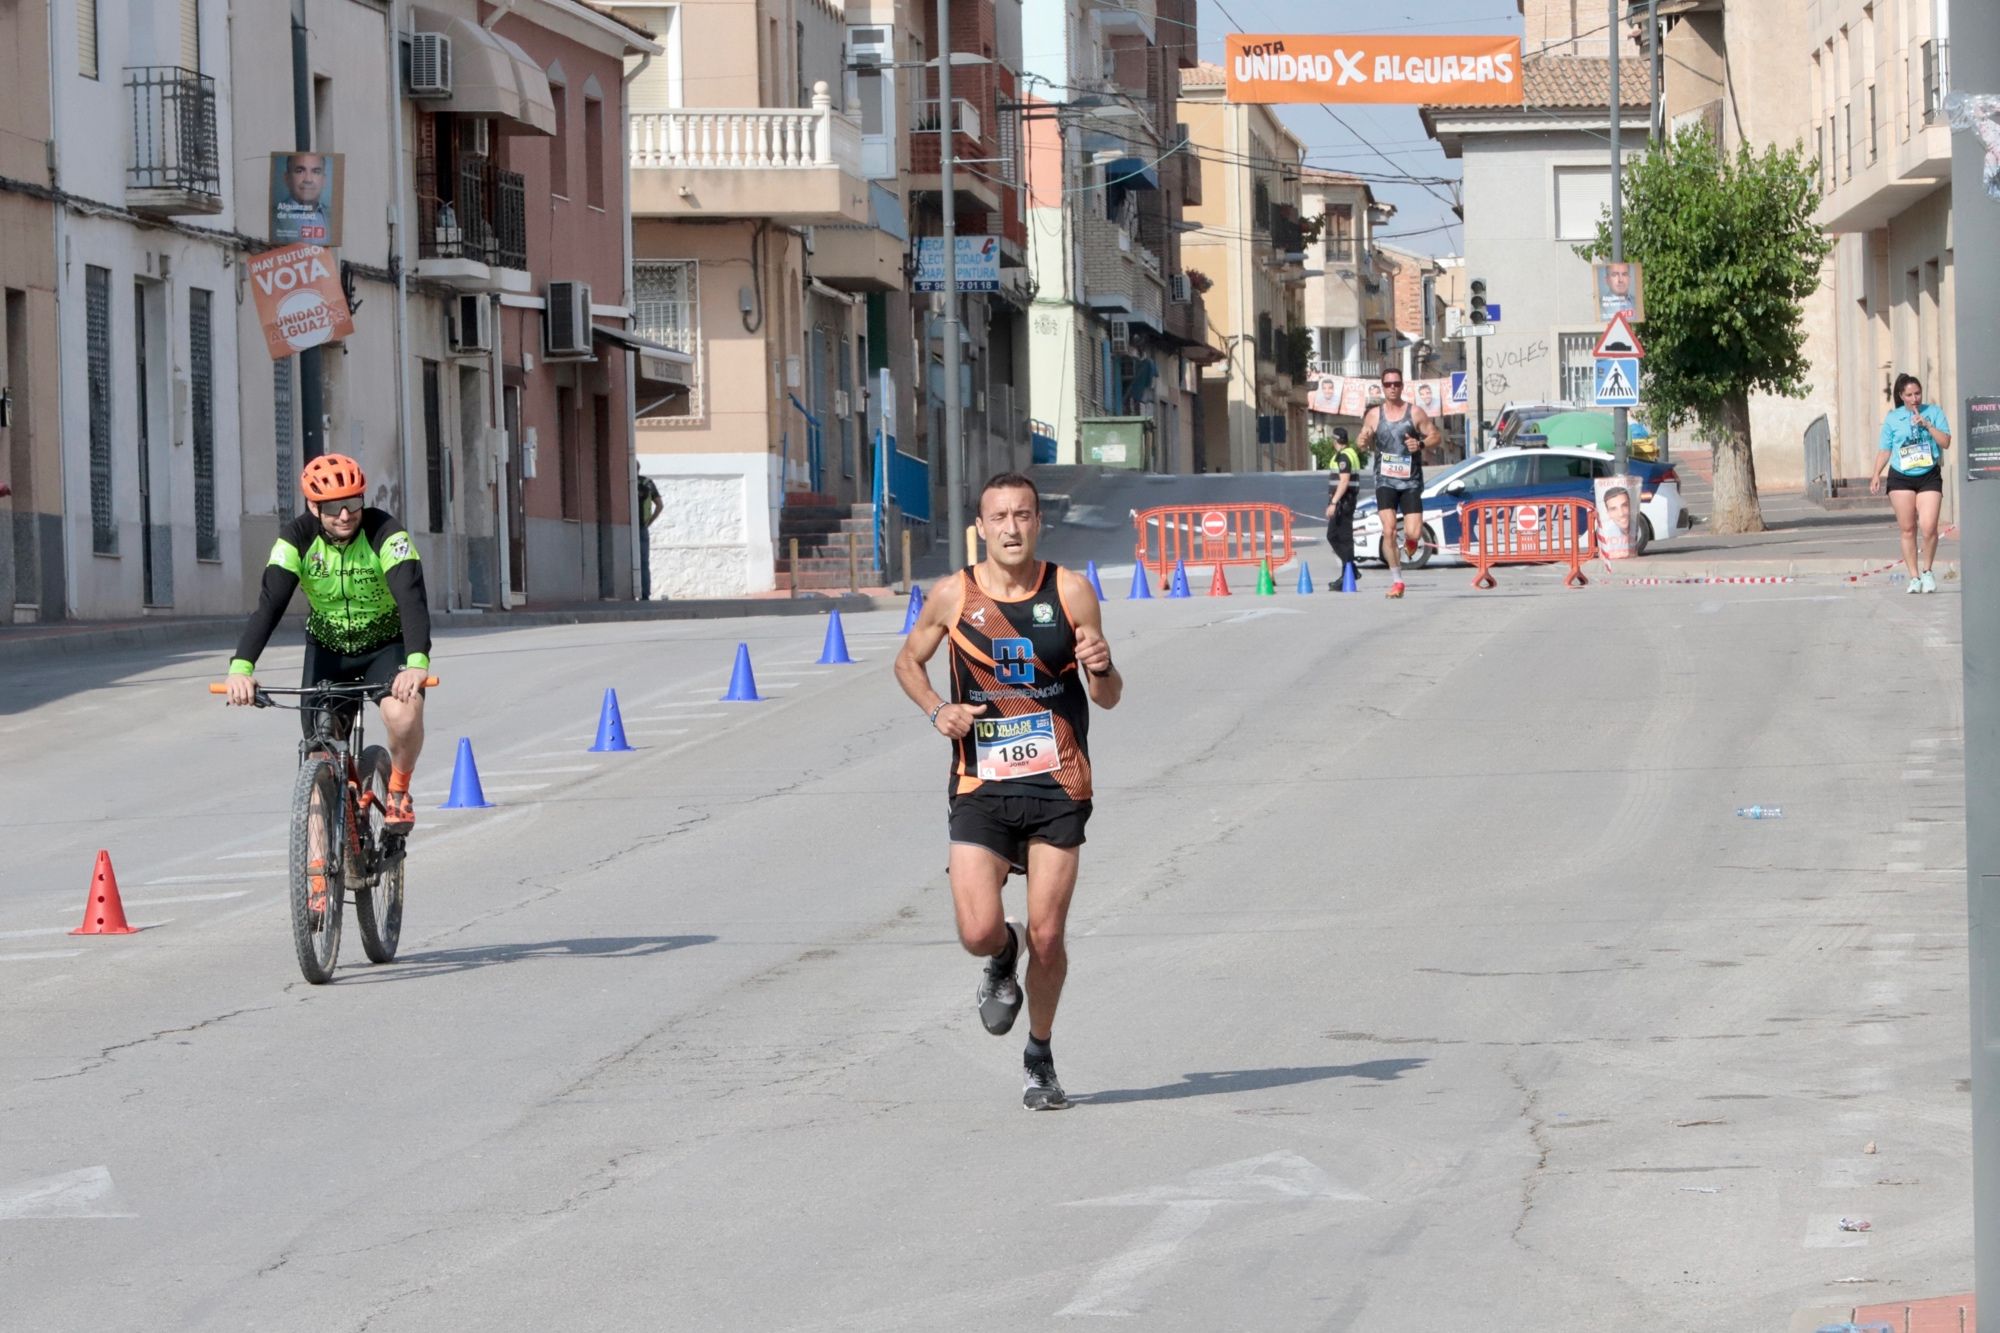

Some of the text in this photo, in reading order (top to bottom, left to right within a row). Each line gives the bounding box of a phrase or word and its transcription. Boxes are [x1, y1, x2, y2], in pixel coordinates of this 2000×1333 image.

[1242, 41, 1284, 57] VOTA
[1235, 49, 1513, 86] UNIDAD X ALGUAZAS
[277, 202, 313, 212] Alguazas
[256, 259, 331, 296] VOTA
[957, 267, 996, 278] PINTURA
[966, 281, 978, 290] 01
[981, 281, 992, 290] 18
[275, 304, 324, 328] UNIDAD
[271, 311, 345, 343] ALGUAZAS
[1972, 404, 1996, 412] PUENTE
[999, 742, 1039, 763] 186
